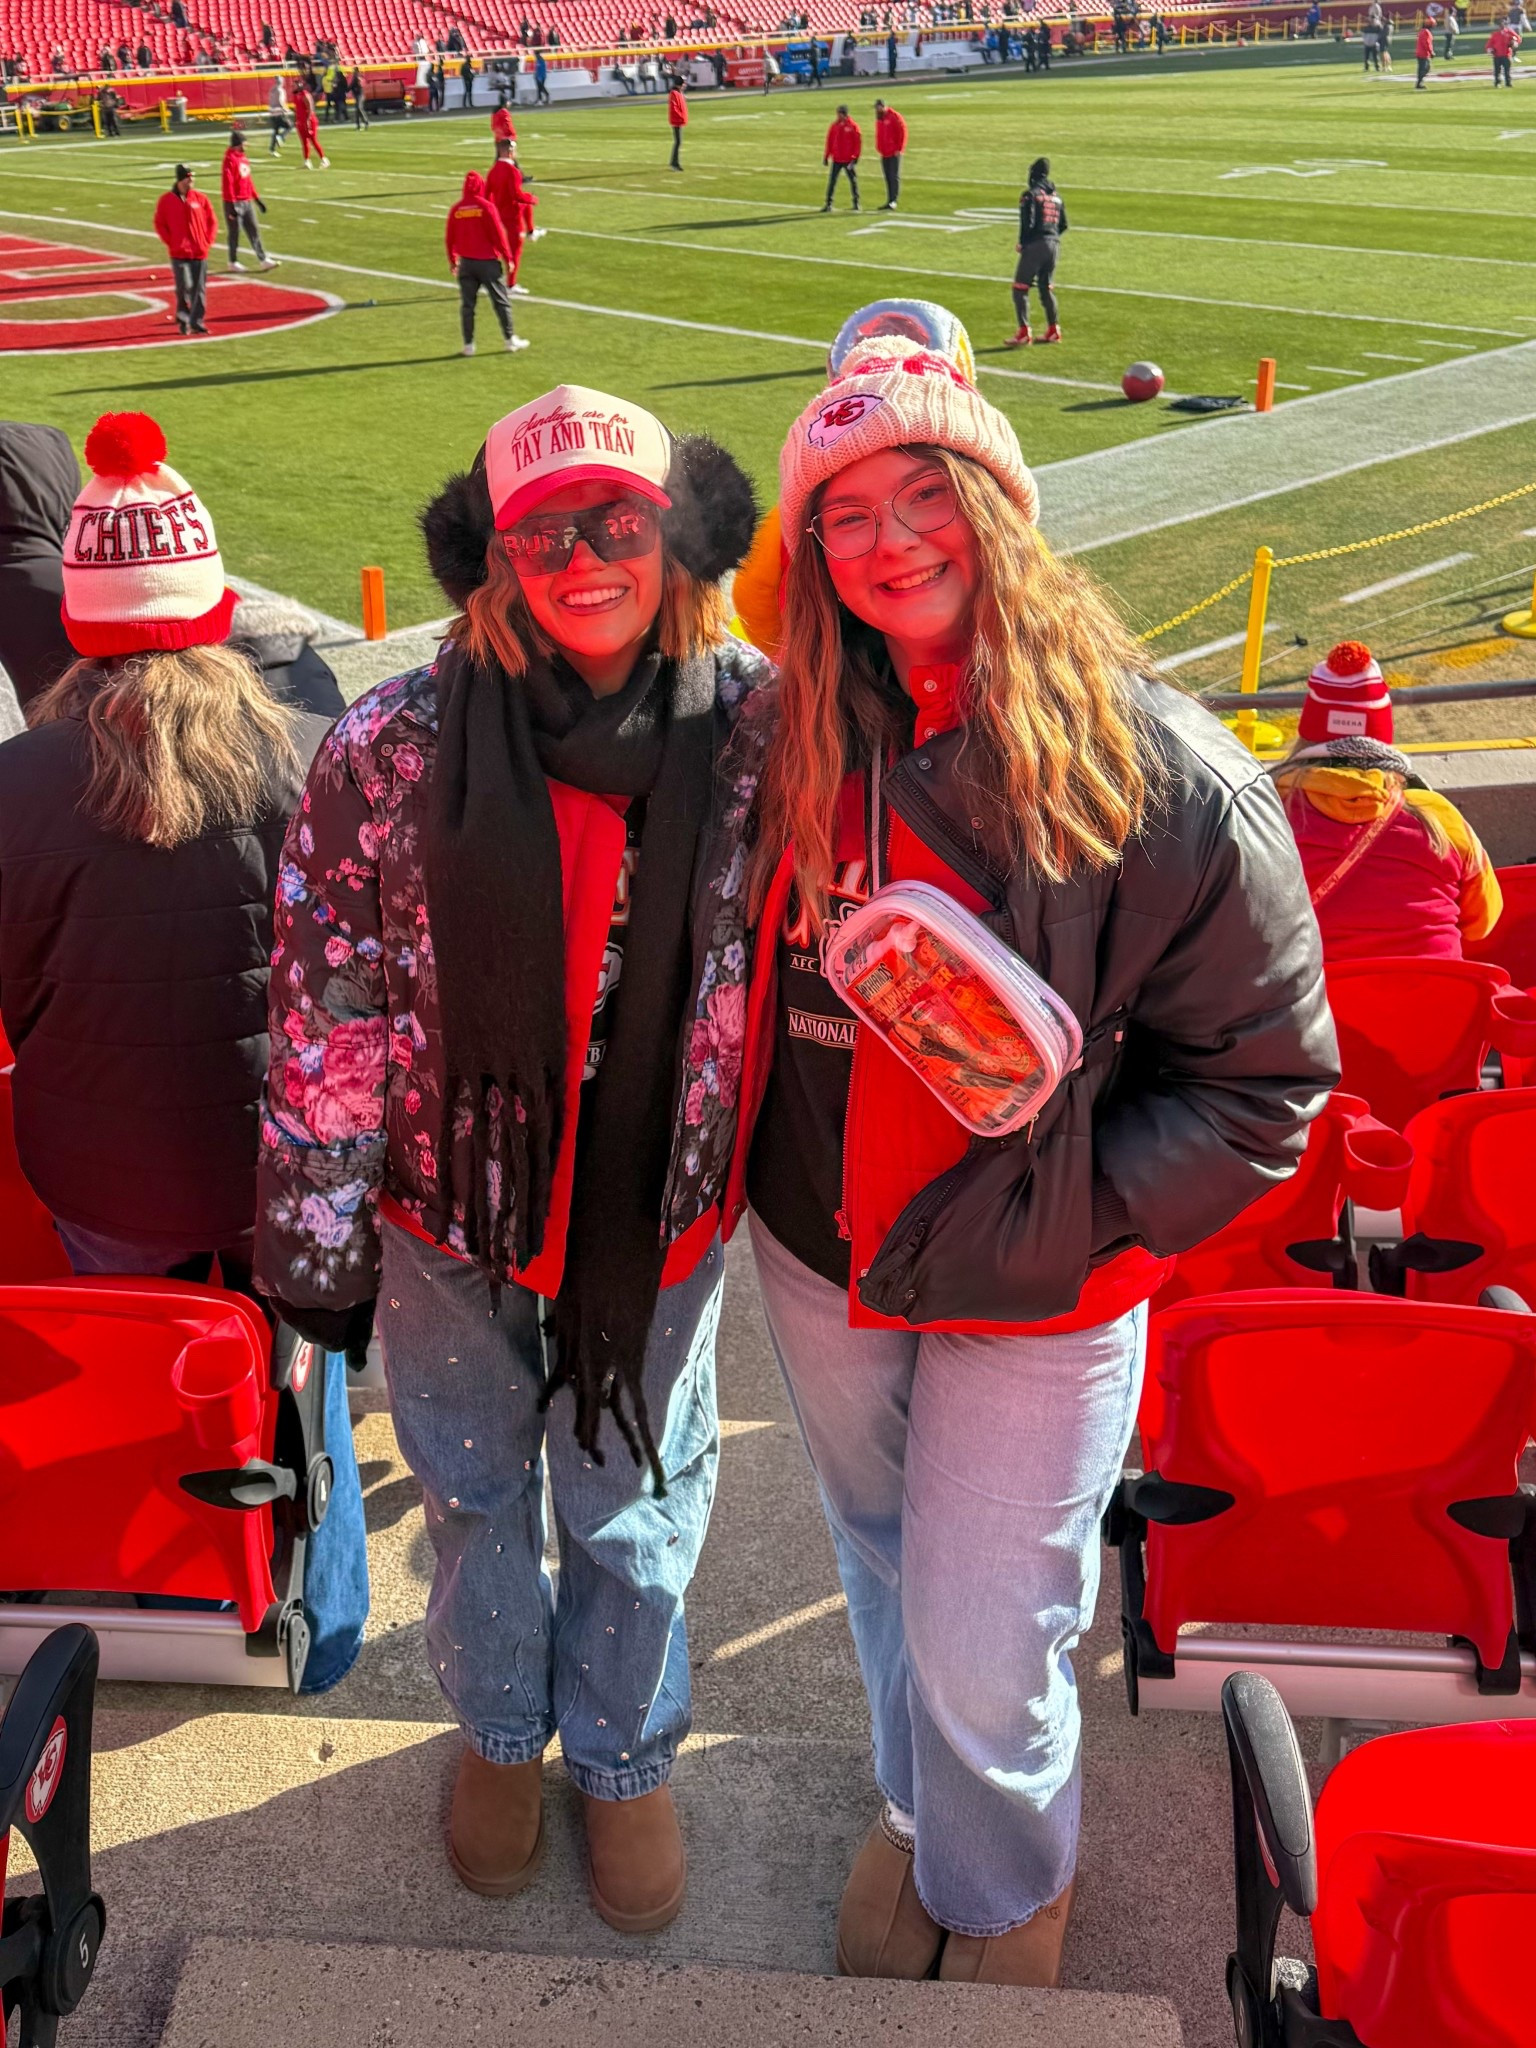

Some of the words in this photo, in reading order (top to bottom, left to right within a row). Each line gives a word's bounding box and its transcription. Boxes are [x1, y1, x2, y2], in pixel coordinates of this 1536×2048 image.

[511, 405, 578, 444] Sundays
[581, 410, 605, 419] are
[607, 413, 629, 428] for
[511, 430, 542, 472] TAY
[550, 421, 585, 455] AND
[75, 499, 209, 562] CHIEFS
[791, 956, 815, 970] AFC
[789, 1012, 857, 1044] NATIONAL
[79, 1933, 89, 1968] 5
